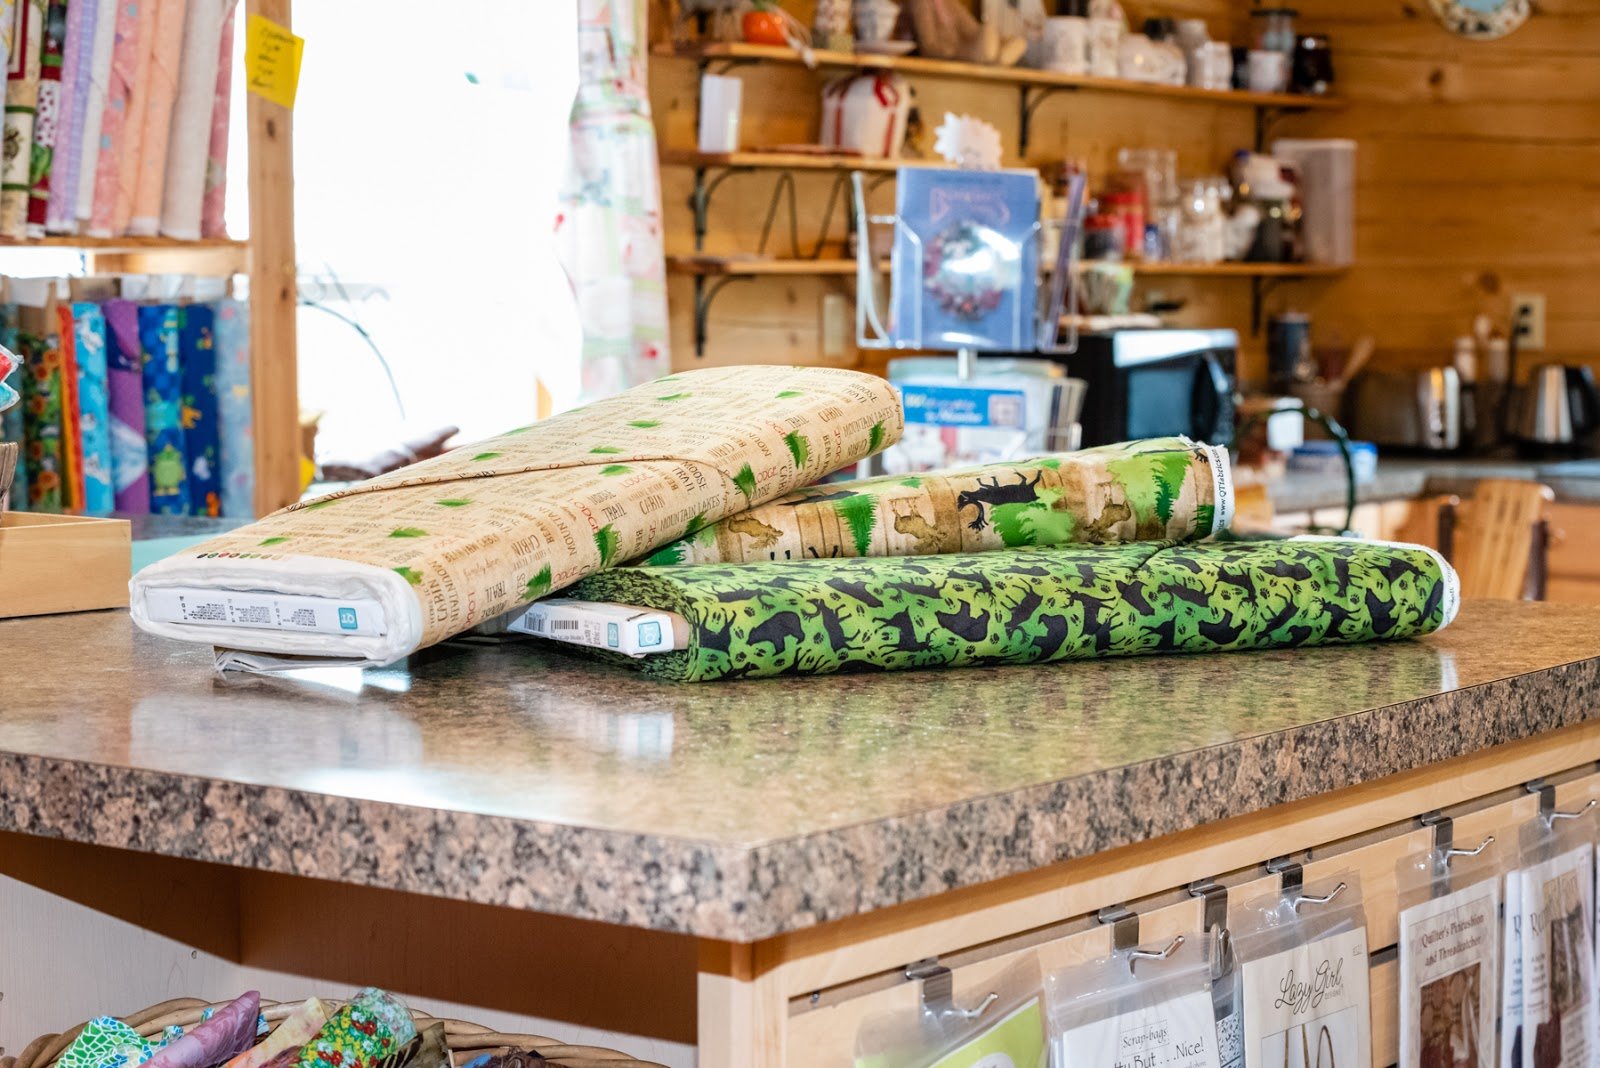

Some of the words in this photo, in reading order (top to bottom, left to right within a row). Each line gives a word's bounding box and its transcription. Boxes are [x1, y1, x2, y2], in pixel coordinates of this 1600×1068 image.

[681, 461, 708, 491] MOOSE
[601, 503, 627, 522] TRAIL
[639, 494, 666, 515] CABIN
[660, 506, 697, 532] MOUNTAIN
[697, 494, 721, 513] LAKES
[511, 534, 540, 556] CABIN
[428, 579, 448, 622] CABIN
[485, 580, 507, 602] TRAIL
[1421, 928, 1450, 949] Quilter's
[1449, 913, 1485, 939] Pincushion
[1424, 953, 1438, 968] and
[1437, 935, 1482, 963] Threadcatcher
[1275, 969, 1314, 1015] Lazy
[1311, 957, 1343, 1008] Girl
[1122, 1026, 1168, 1050] Scrap-bags
[1134, 1051, 1157, 1068] But
[1175, 1036, 1205, 1058] Nice!
